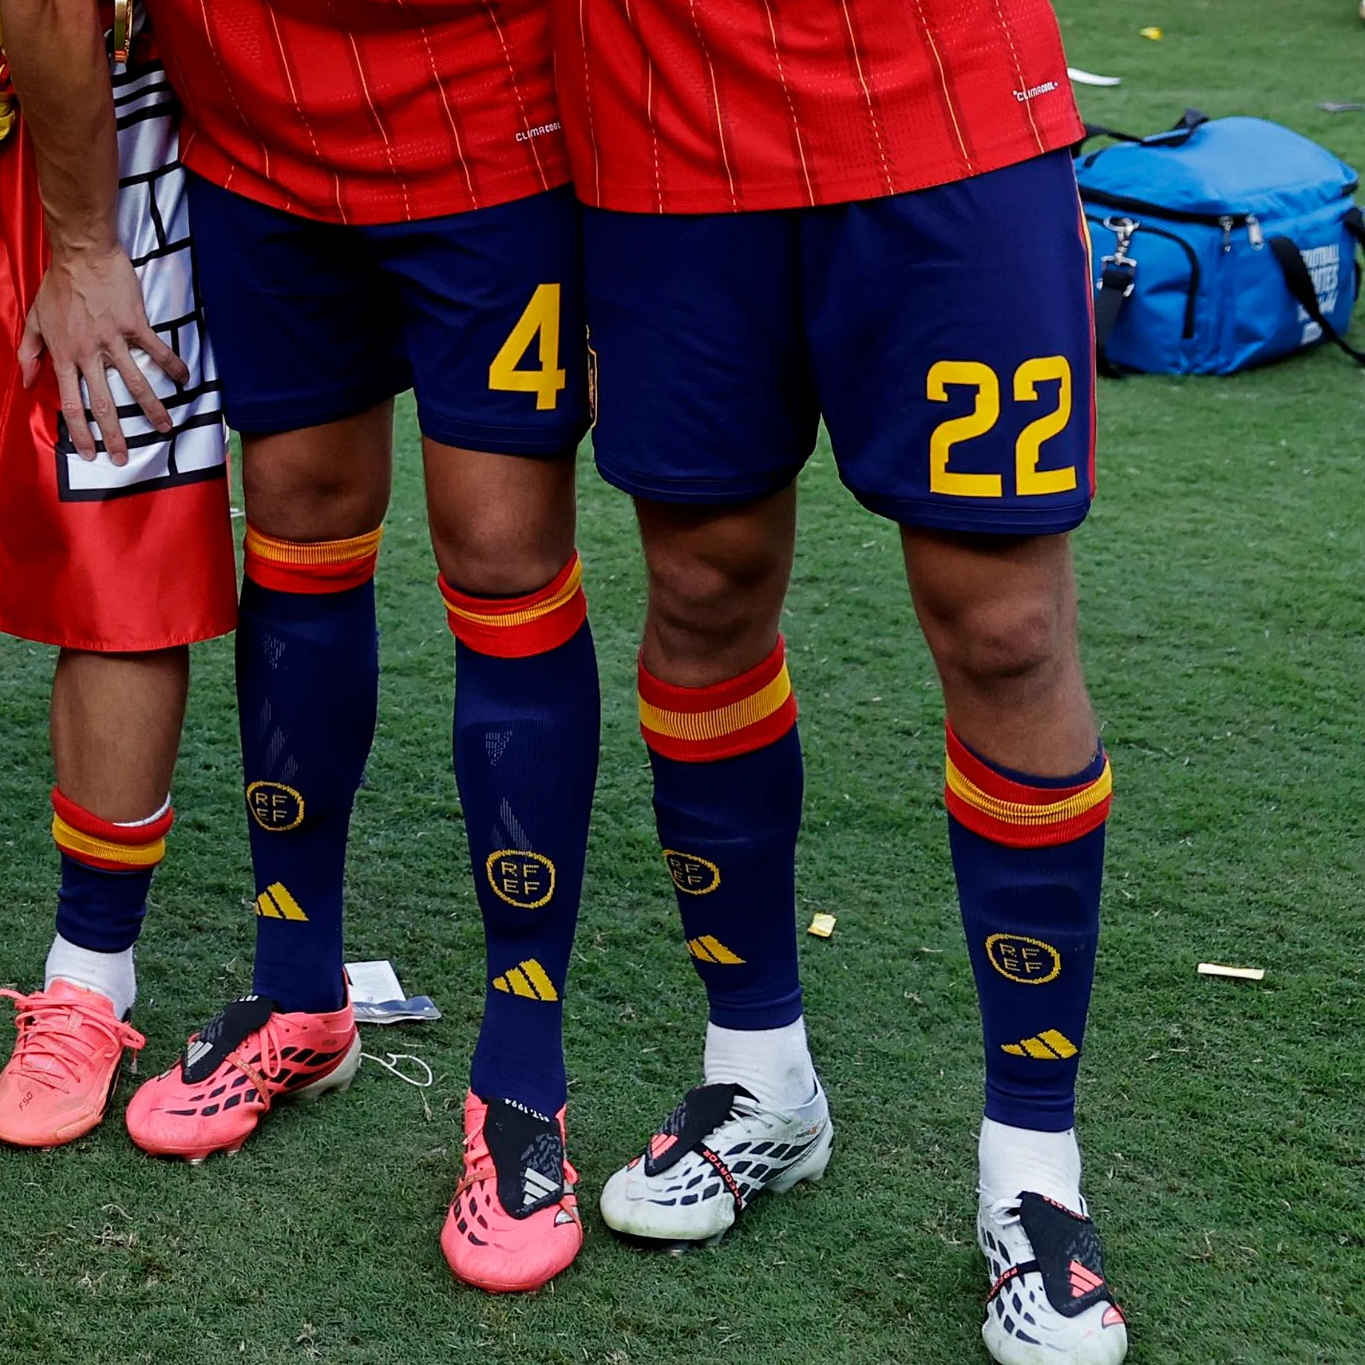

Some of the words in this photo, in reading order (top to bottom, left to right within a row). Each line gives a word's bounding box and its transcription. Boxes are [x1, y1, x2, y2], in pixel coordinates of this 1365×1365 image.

[488, 283, 567, 411] 4
[926, 355, 1078, 498] 22
[255, 792, 288, 806] RF
[256, 807, 288, 823] EF
[500, 860, 540, 879] RF
[502, 878, 541, 896] EF
[1000, 942, 1041, 959] RF
[1004, 957, 1043, 974] EF
